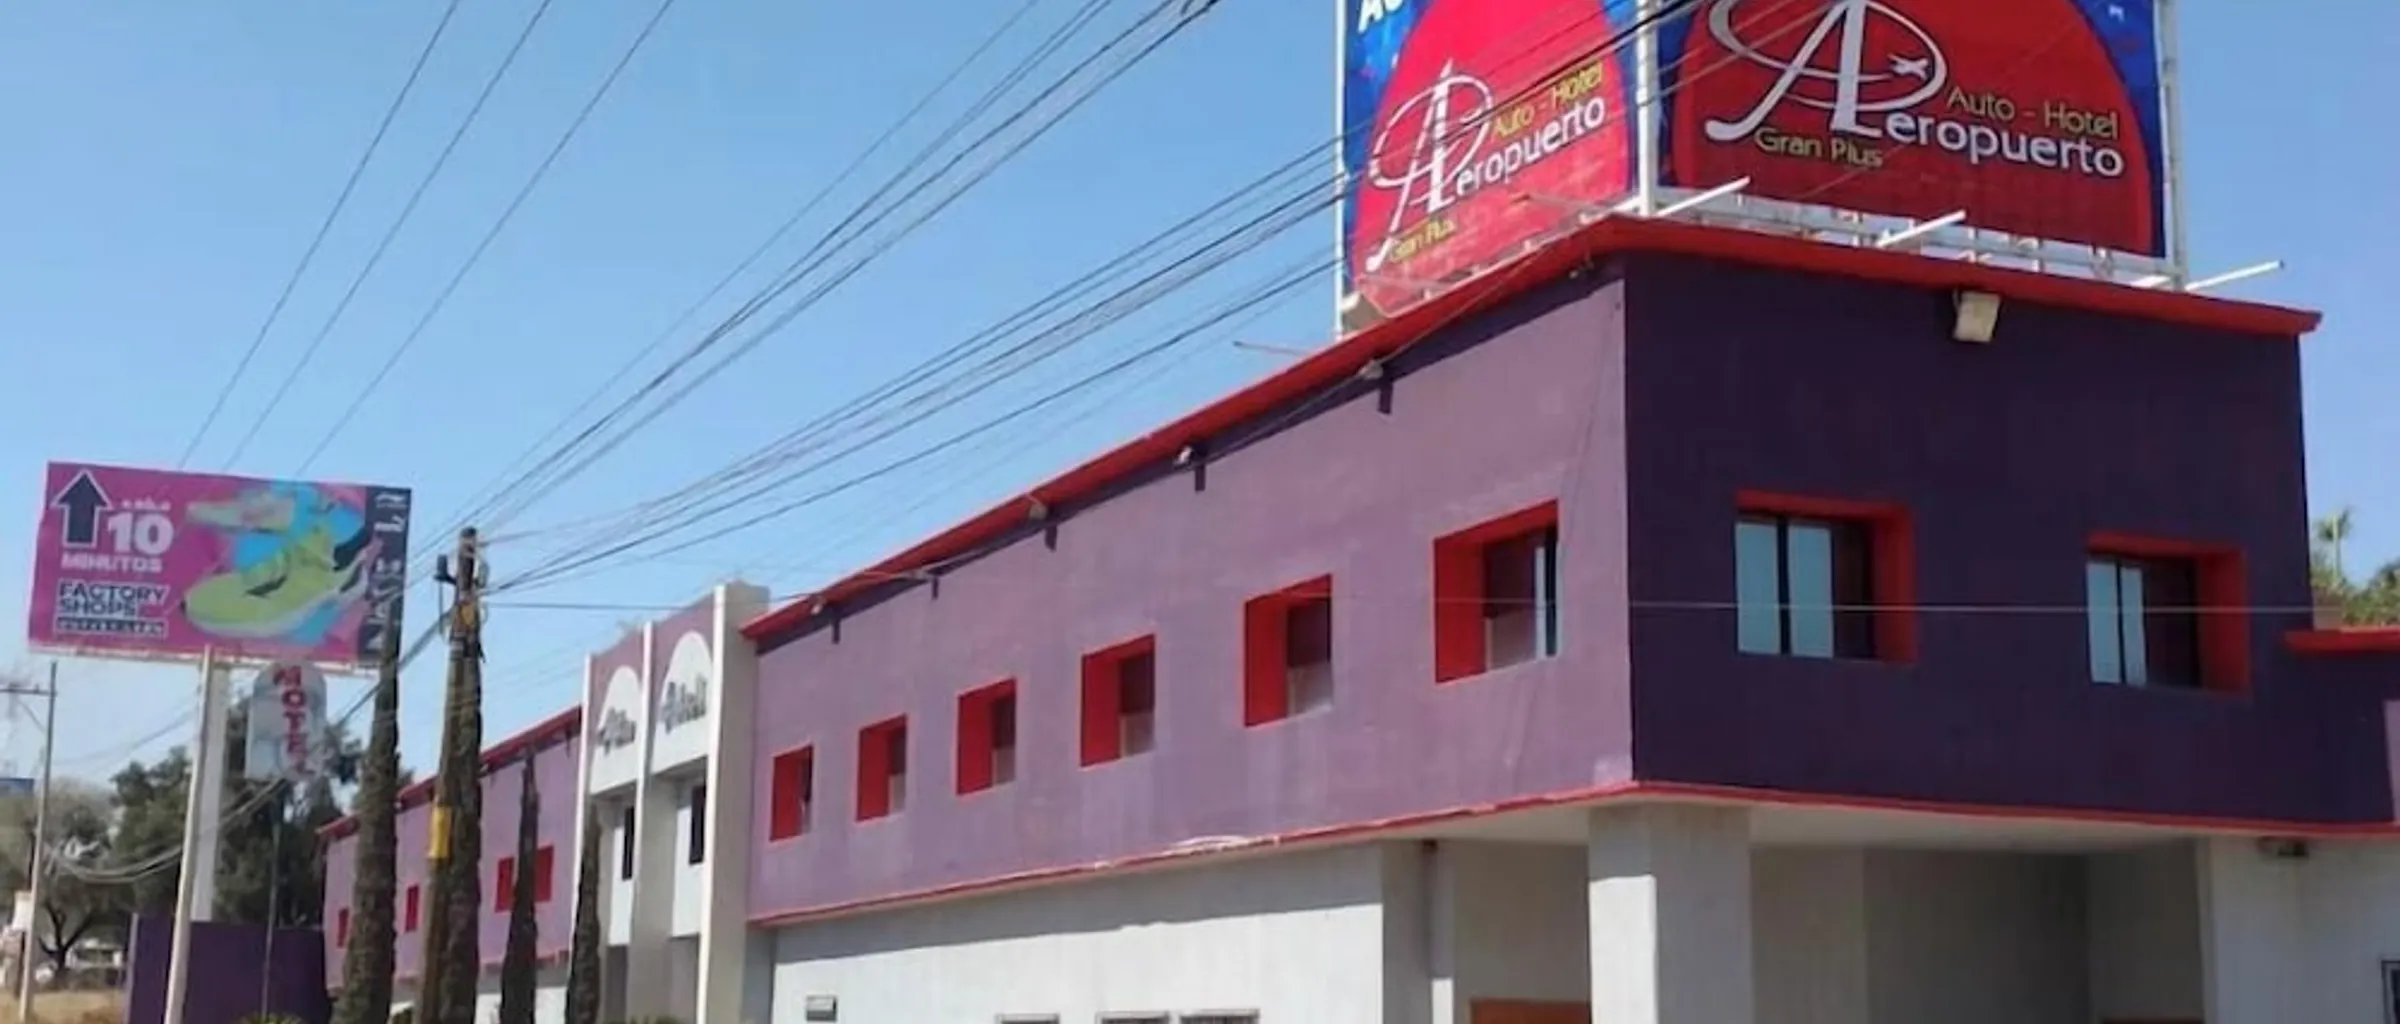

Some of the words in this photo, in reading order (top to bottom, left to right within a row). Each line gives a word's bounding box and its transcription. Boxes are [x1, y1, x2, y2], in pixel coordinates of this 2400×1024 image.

[1491, 102, 1535, 140] Auto
[1550, 60, 1604, 111] Hotel
[1704, 0, 2125, 179] Aeropuerto
[1947, 84, 2016, 122] Auto
[2043, 99, 2120, 142] Hotel
[1365, 59, 1606, 272] Aeropuerto
[1753, 126, 1823, 160] Gran
[1831, 136, 1884, 169] Plus
[107, 511, 174, 556] 10
[61, 551, 163, 573] MINUTOS
[59, 583, 166, 600] FACTORY
[60, 598, 136, 615] SHOPS
[272, 665, 316, 775] MOTEL
